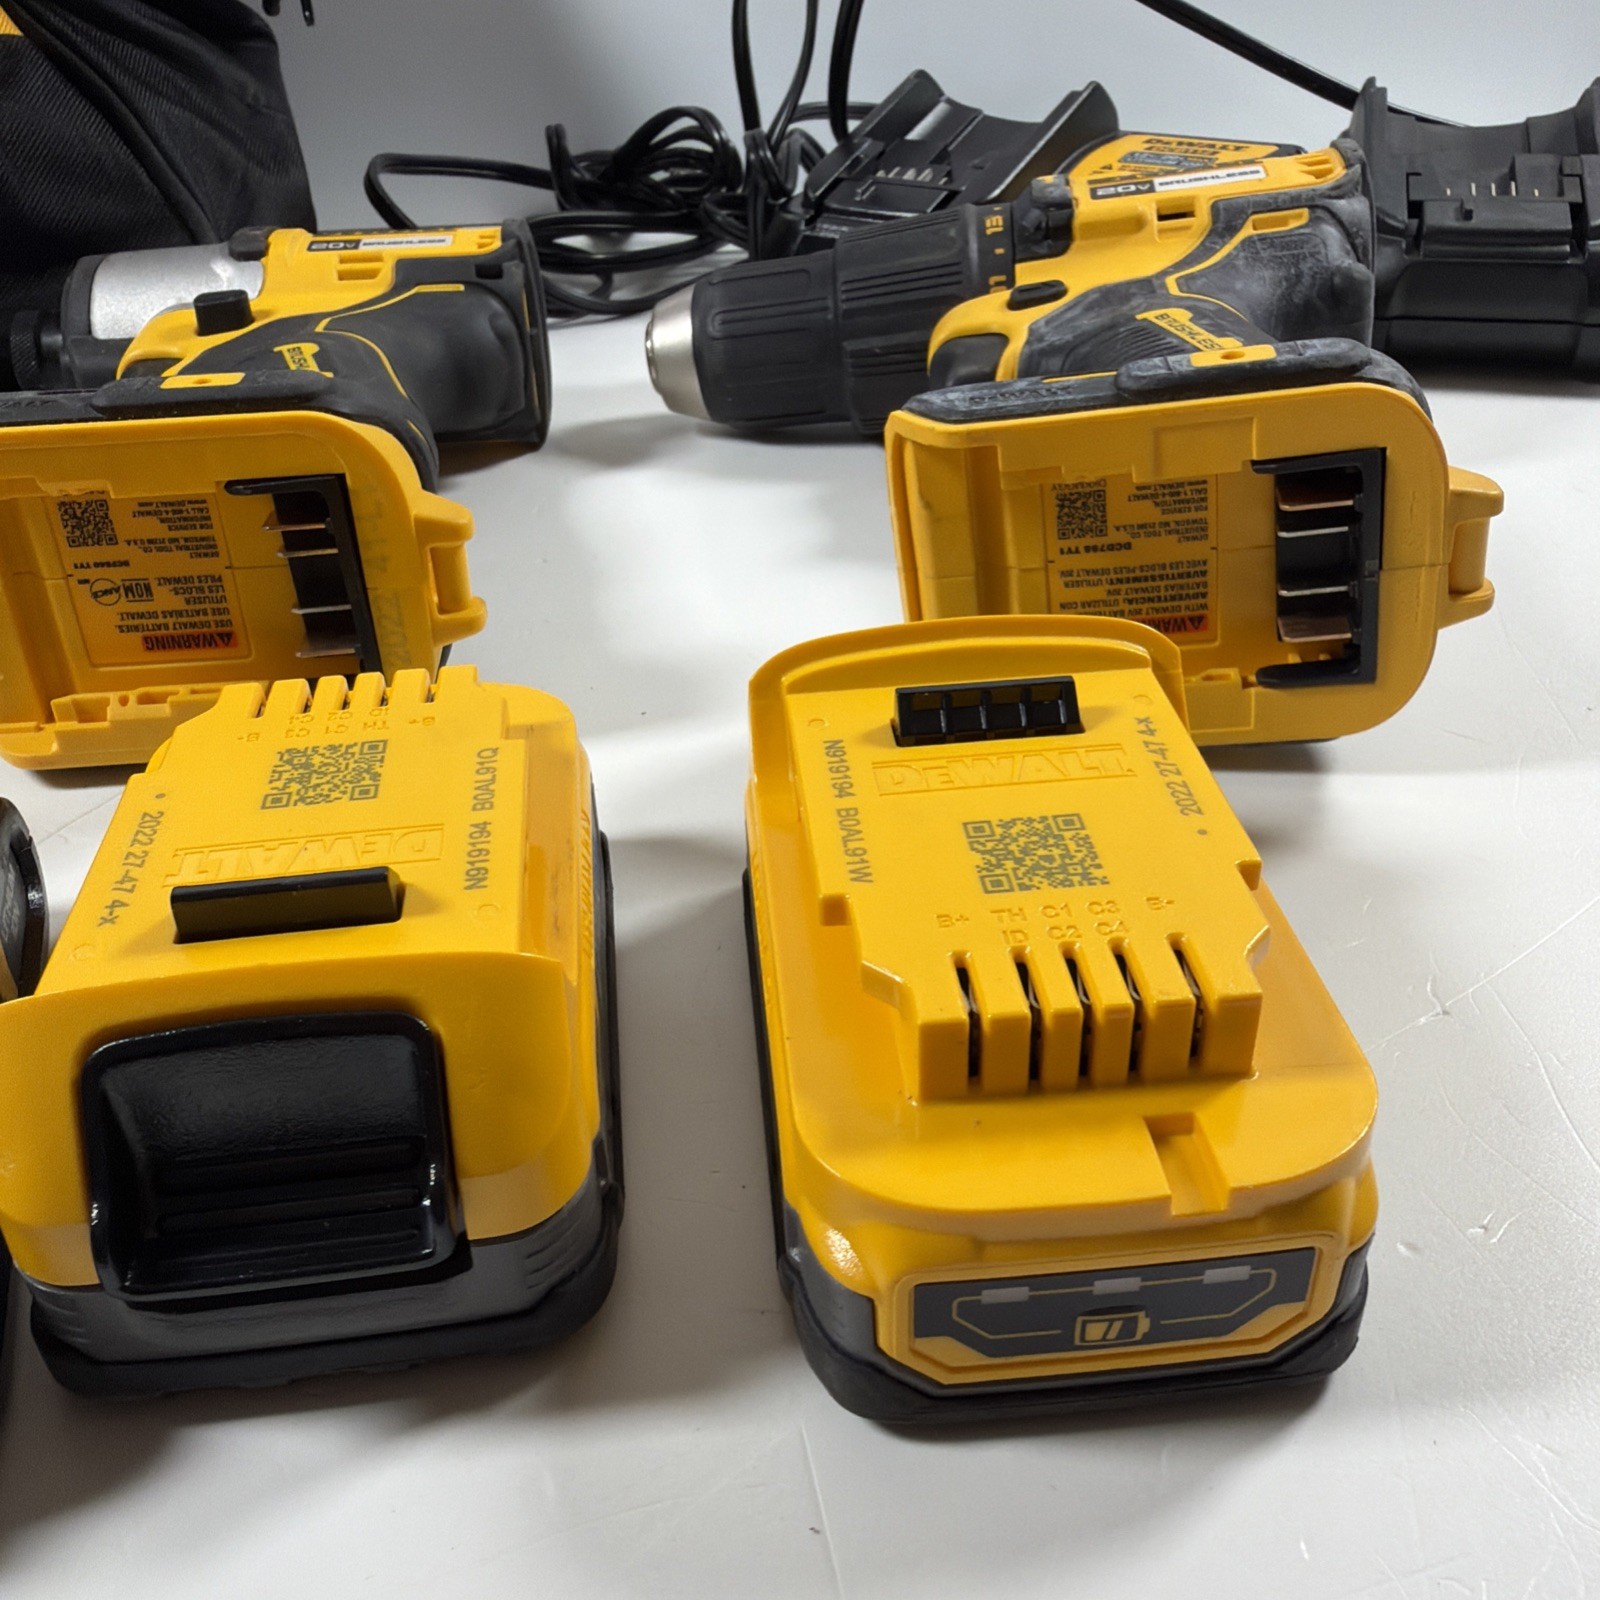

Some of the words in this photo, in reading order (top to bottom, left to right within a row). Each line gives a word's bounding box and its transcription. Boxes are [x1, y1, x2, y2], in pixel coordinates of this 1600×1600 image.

[143, 634, 216, 651] WARNING
[173, 621, 211, 631] DEWALT
[823, 740, 854, 798] N919194
[879, 745, 1132, 792] DEWALT
[1142, 740, 1182, 777] 27-47
[1166, 780, 1205, 816] 2022
[135, 810, 165, 849] 2022
[166, 826, 444, 884] DEWALT
[463, 820, 491, 892] N919194
[115, 854, 145, 895] 27-47
[989, 906, 1028, 924] TH
[1040, 902, 1074, 919] C1
[1086, 899, 1121, 916] C3
[1001, 929, 1030, 946] ID
[1046, 924, 1082, 940] C2
[1094, 920, 1131, 936] C4
